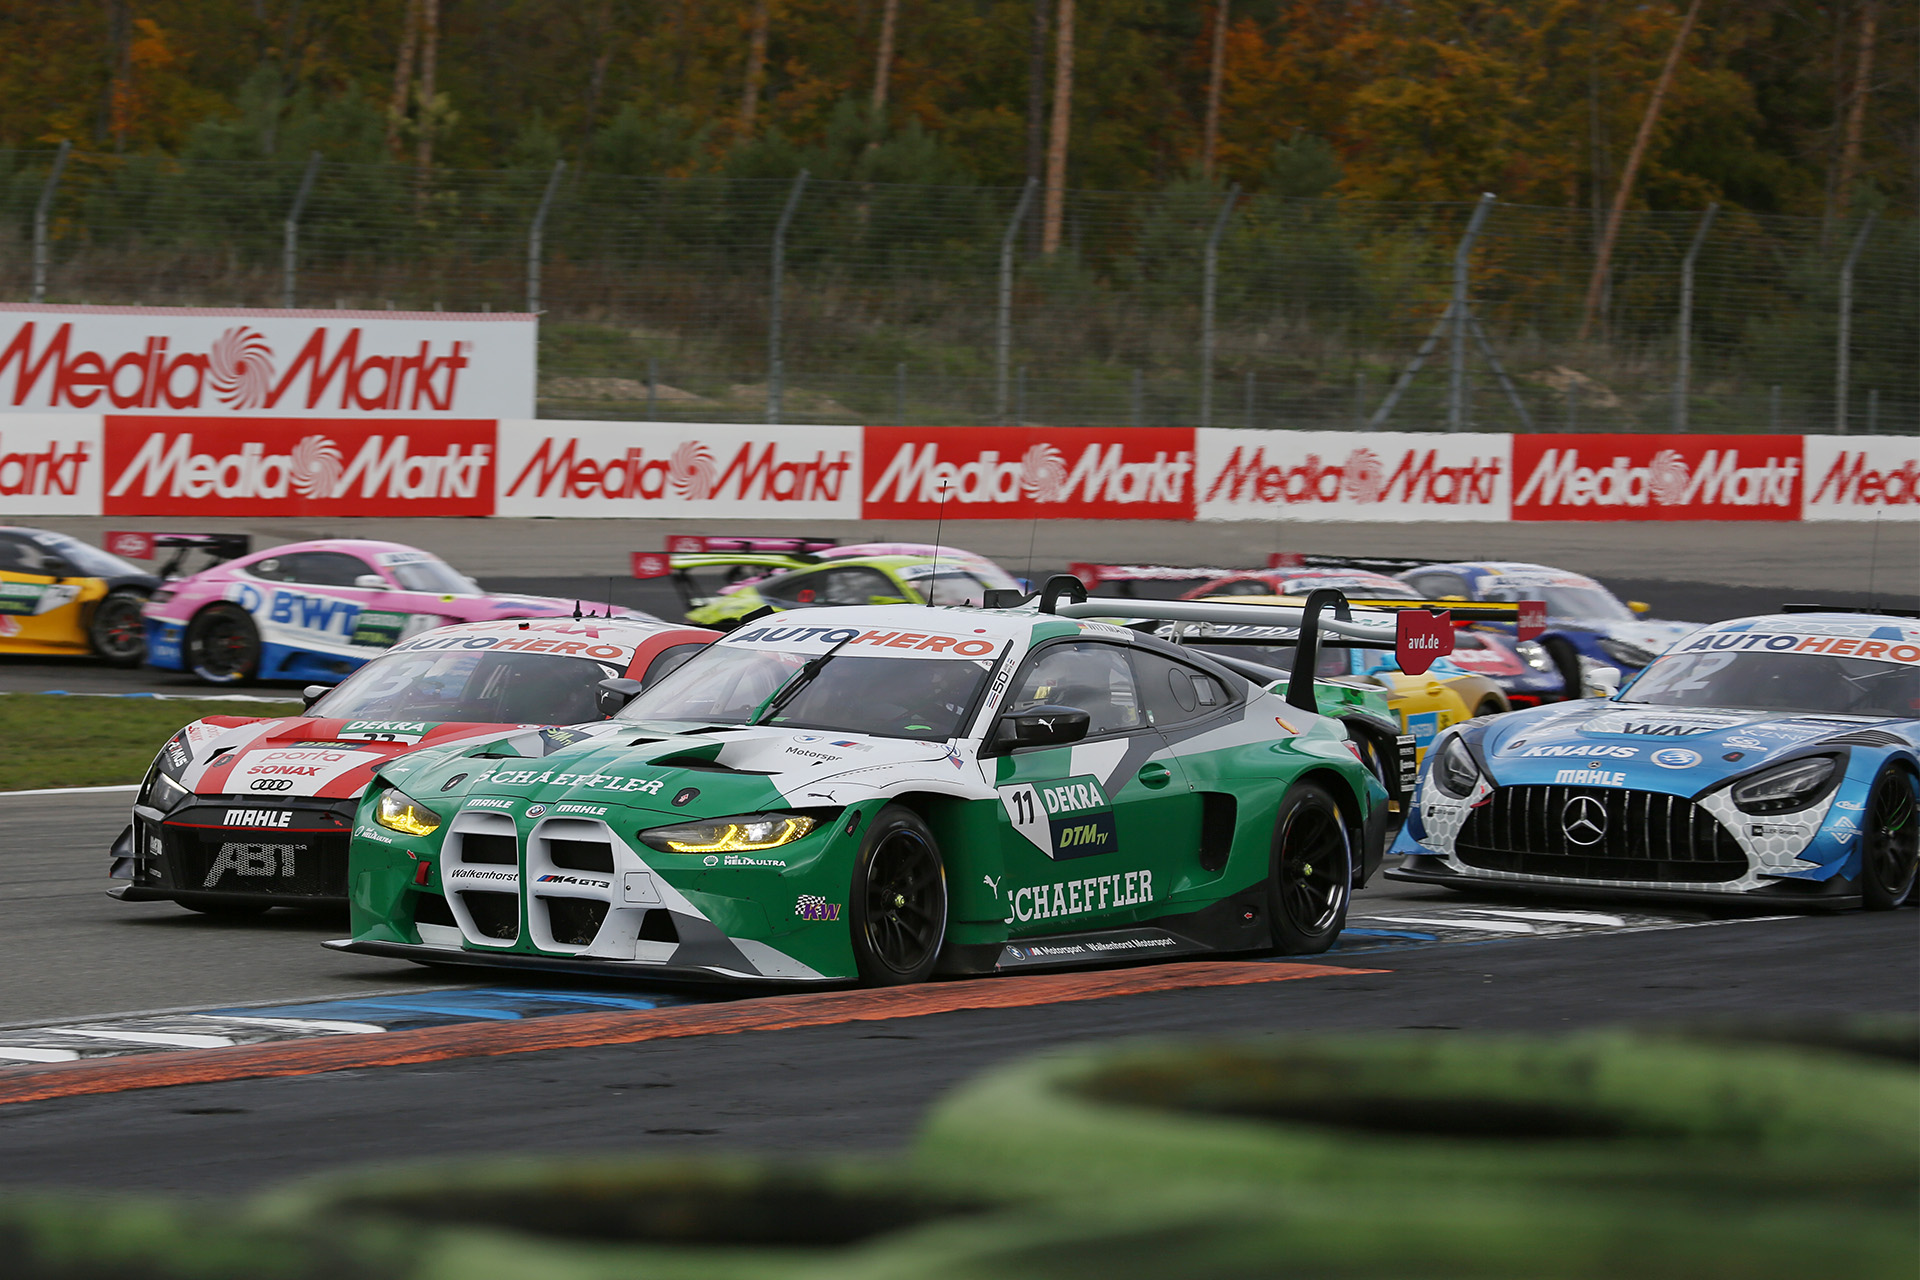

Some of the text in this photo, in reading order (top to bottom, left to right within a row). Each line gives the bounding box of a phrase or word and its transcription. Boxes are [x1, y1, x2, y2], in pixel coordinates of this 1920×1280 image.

[0, 322, 470, 411] Media Markt
[0, 441, 90, 496] arkt
[108, 432, 489, 500] Media Markt
[505, 437, 854, 501] Media Markt
[865, 443, 1191, 503] Media Markt
[1205, 446, 1501, 503] Media Markt
[1514, 449, 1799, 506] Media Markt
[1811, 451, 1920, 505] Medi
[390, 636, 624, 659] AUTOHERO
[729, 626, 994, 656] AUTOHERO
[1408, 634, 1440, 649] avd.de
[1685, 634, 1920, 662] AUTOHERO
[346, 720, 426, 732] DEKRA
[260, 750, 347, 763] porta
[1521, 745, 1640, 758] KNAUS
[247, 765, 322, 777] SONAX
[473, 769, 664, 796] SCHAEFFLER
[1554, 769, 1627, 786] MAHLE
[466, 799, 514, 809] MAHLE
[555, 803, 608, 816] MAHLE
[1011, 790, 1035, 825] 11
[1043, 782, 1104, 814] DEKRA
[223, 809, 293, 828] MAHLE
[203, 842, 296, 888] ABT
[451, 868, 520, 882] Walkenhorst
[803, 904, 842, 921] KW
[1045, 945, 1086, 956] Motorsport
[1132, 937, 1177, 949] Motorsport
